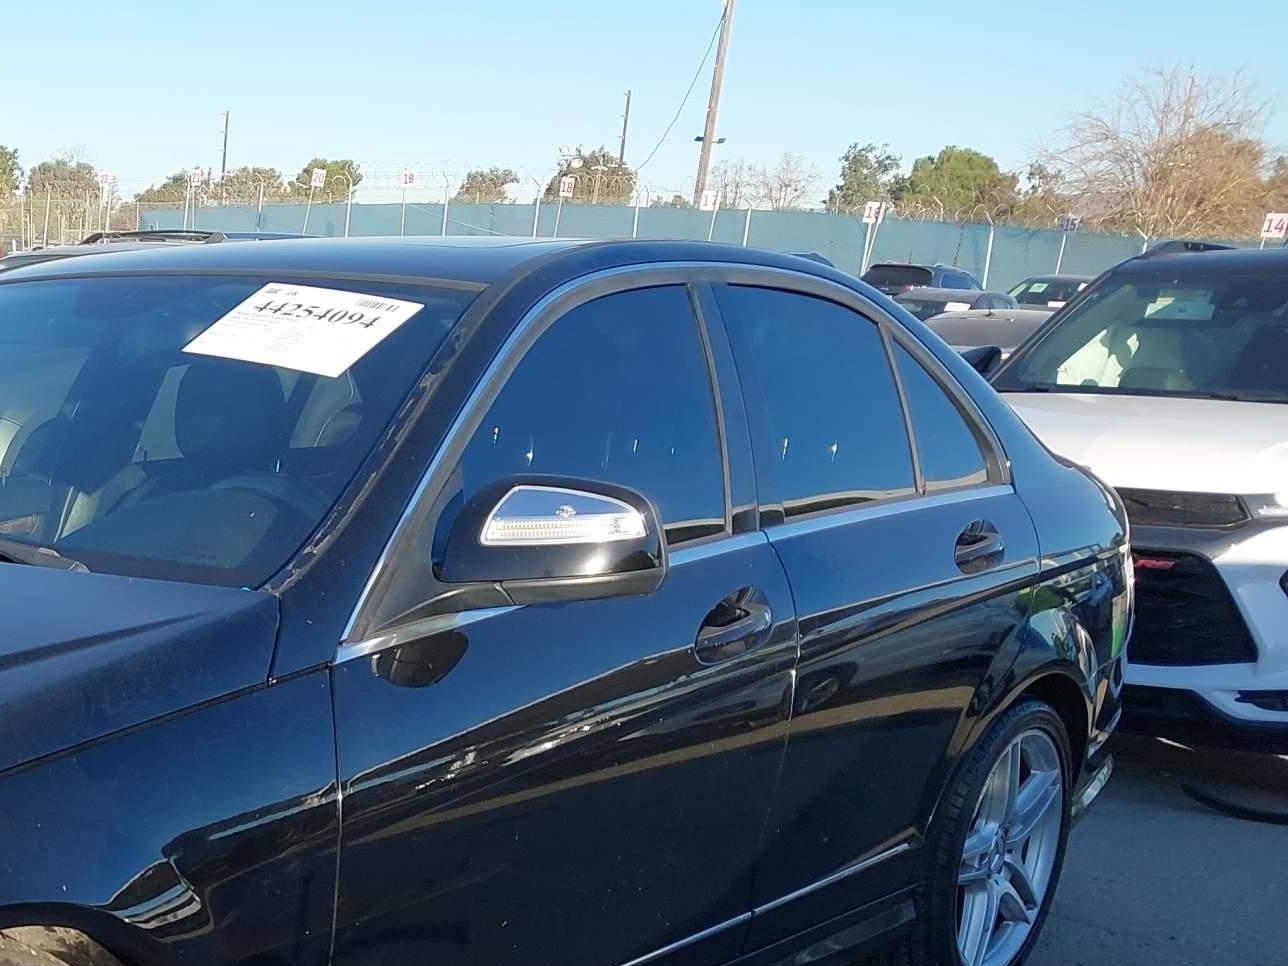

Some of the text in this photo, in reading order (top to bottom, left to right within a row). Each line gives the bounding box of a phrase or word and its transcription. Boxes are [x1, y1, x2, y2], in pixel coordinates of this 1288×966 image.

[192, 172, 200, 183] 21
[313, 171, 325, 184] 20
[402, 172, 415, 185] 19
[560, 181, 573, 193] 18
[1263, 217, 1286, 233] 14
[253, 300, 382, 328] 44254094
